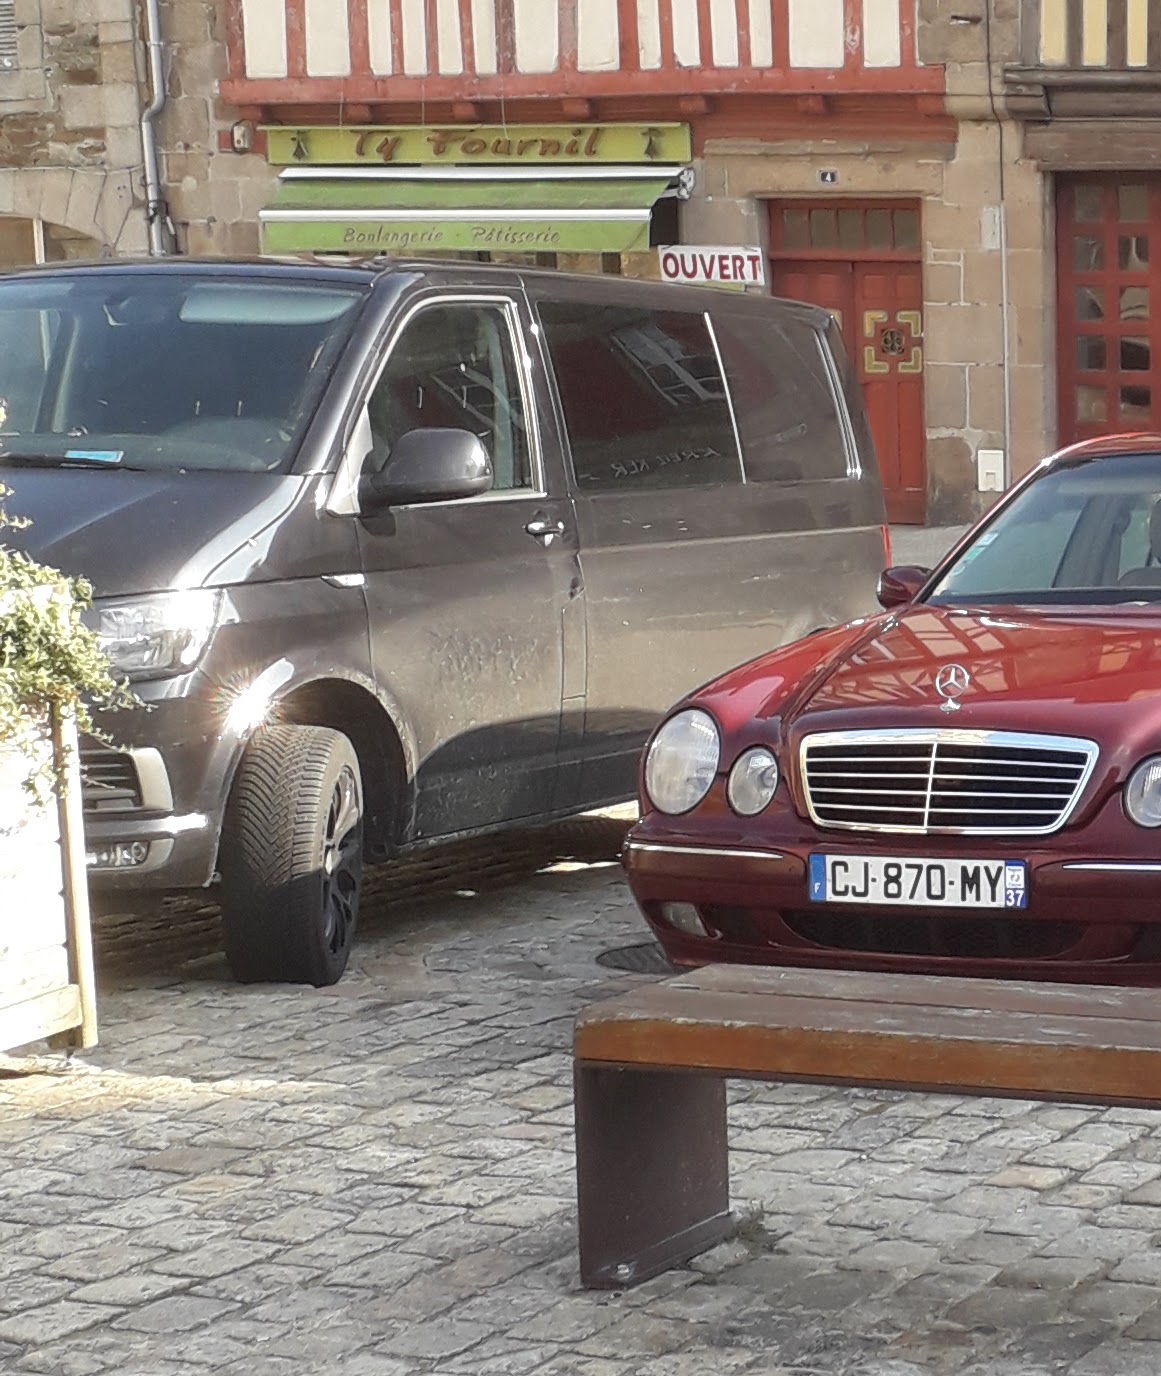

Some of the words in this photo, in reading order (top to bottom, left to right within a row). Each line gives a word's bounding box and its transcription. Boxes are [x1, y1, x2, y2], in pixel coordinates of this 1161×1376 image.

[427, 127, 600, 157] Fournil
[343, 224, 444, 247] Boulangerie
[662, 252, 760, 281] OUVERT
[814, 882, 821, 893] F
[831, 860, 1004, 903] CJ-870-MY
[1006, 889, 1024, 907] 37
